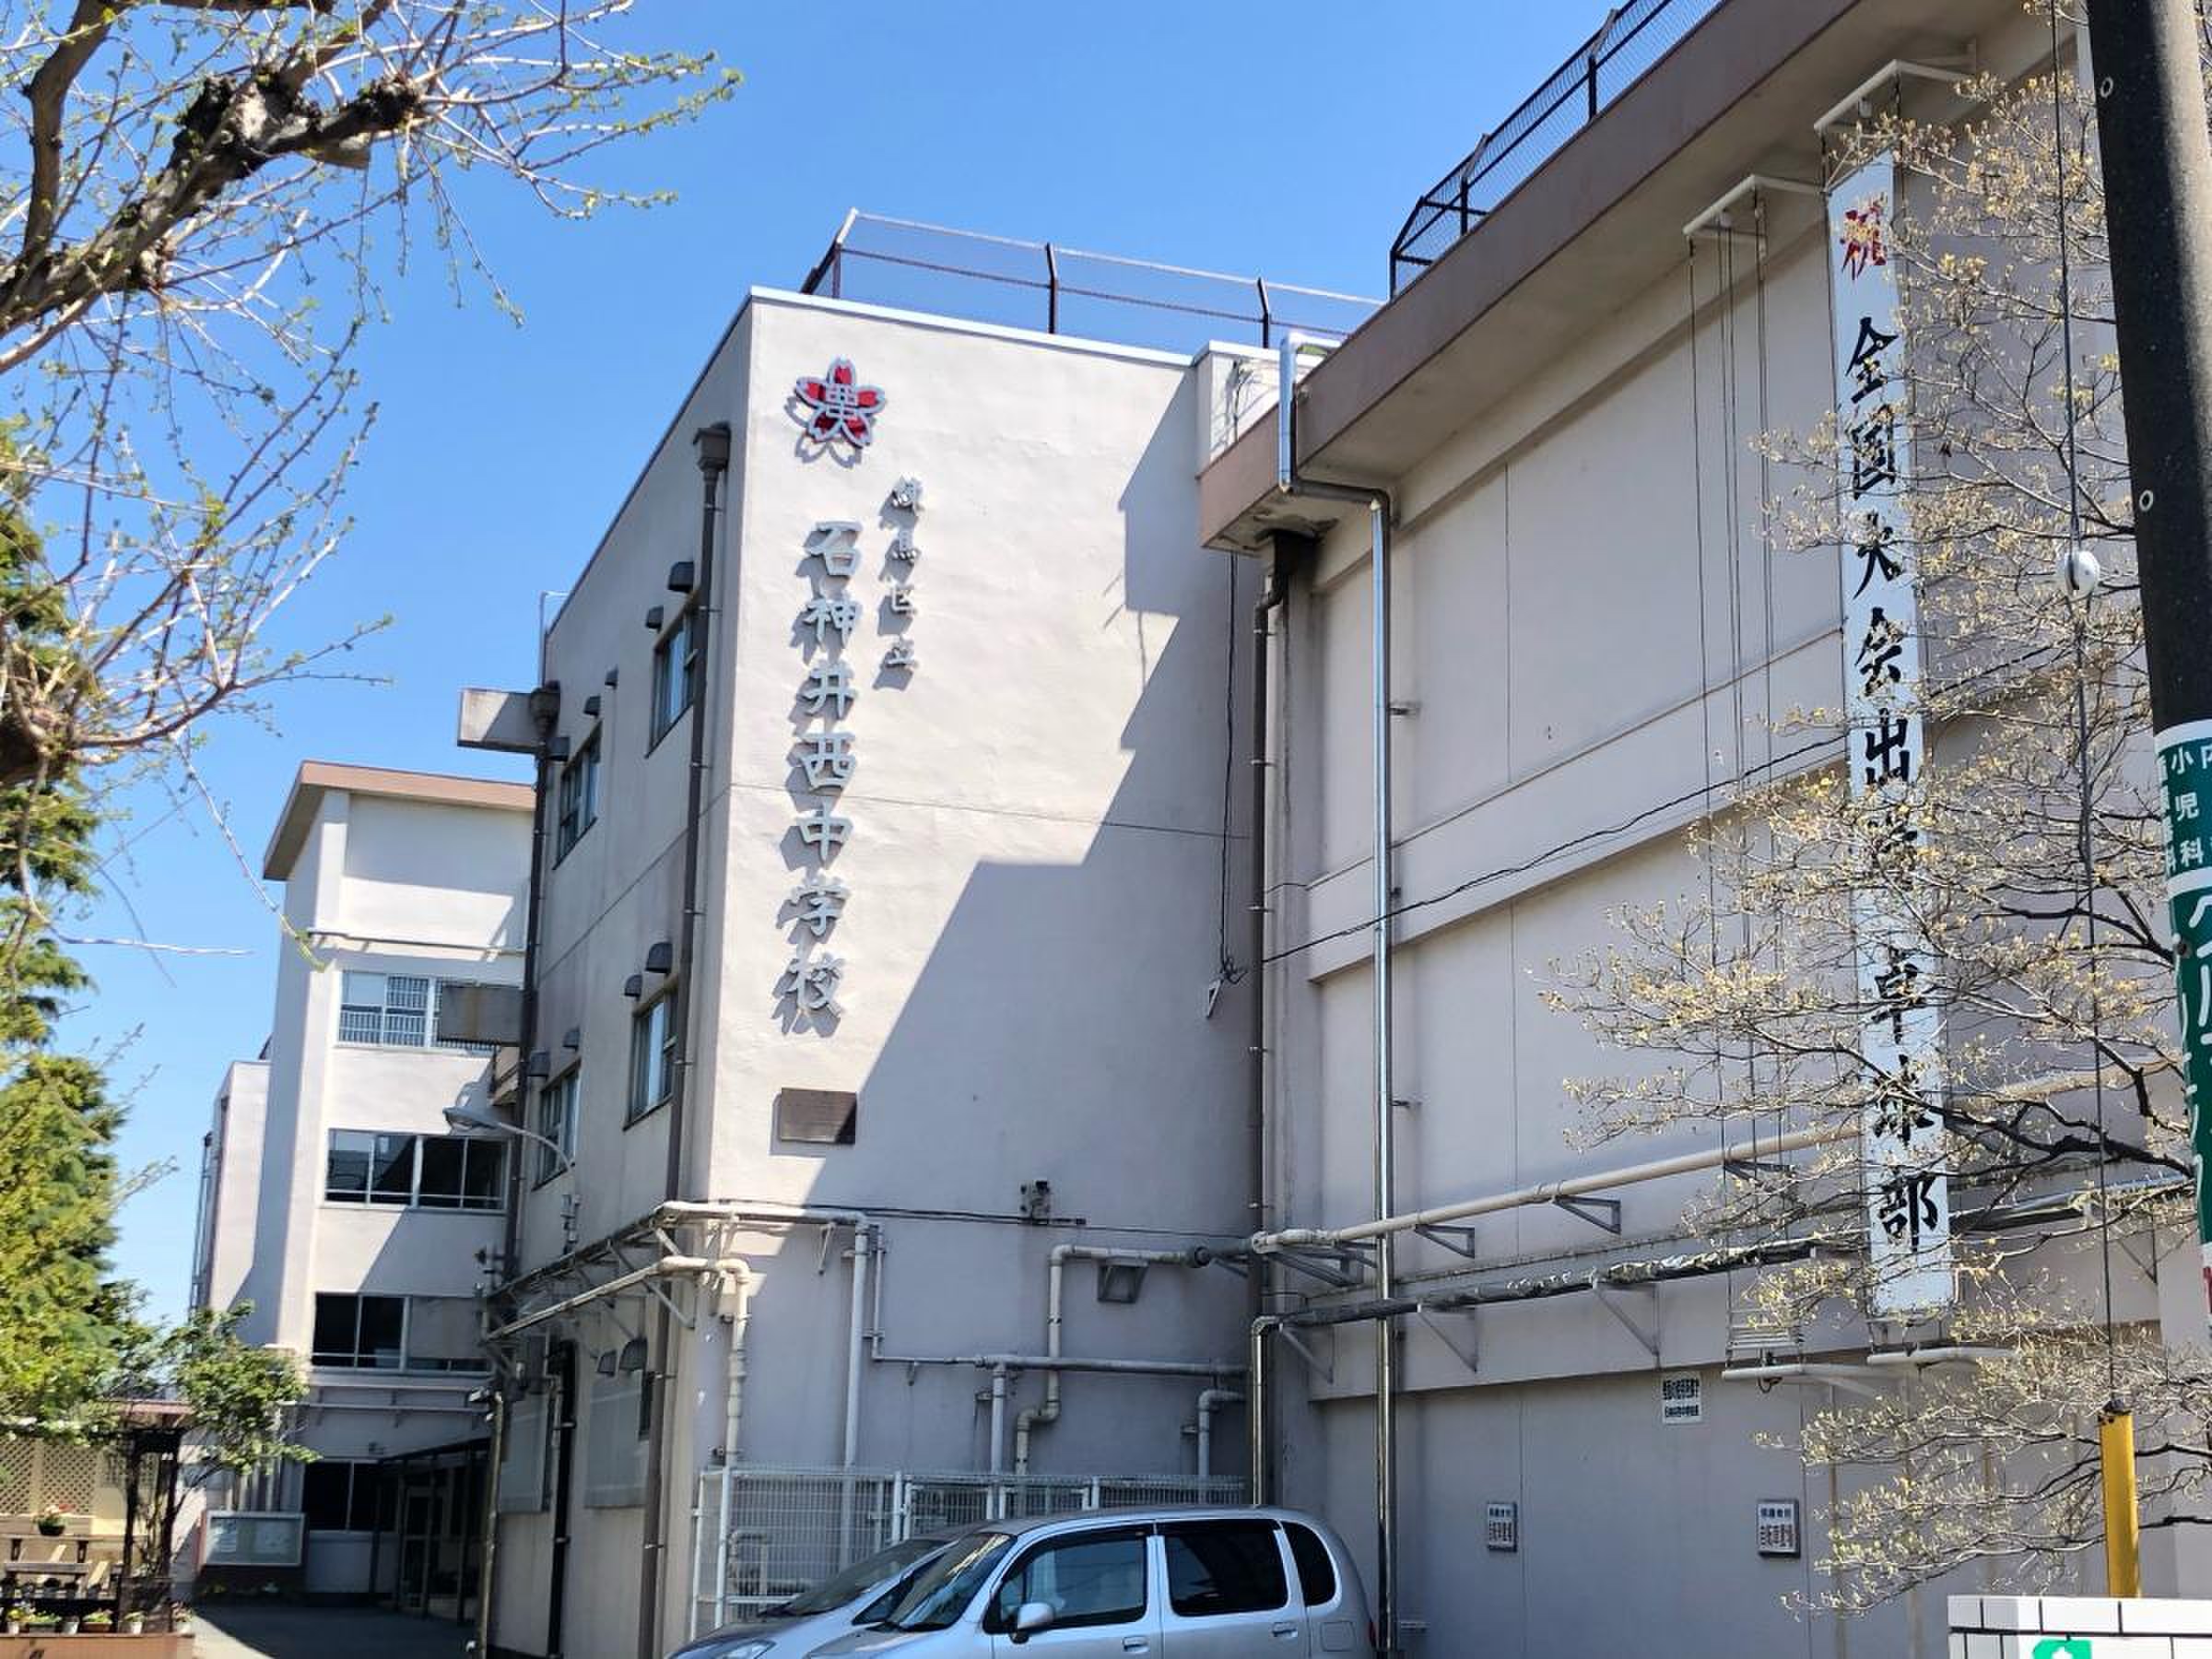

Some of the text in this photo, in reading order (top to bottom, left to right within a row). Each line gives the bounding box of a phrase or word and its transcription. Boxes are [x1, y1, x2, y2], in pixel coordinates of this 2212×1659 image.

[783, 520, 863, 1016] 石神井西中学校
[2171, 746, 2204, 867] 小児科
